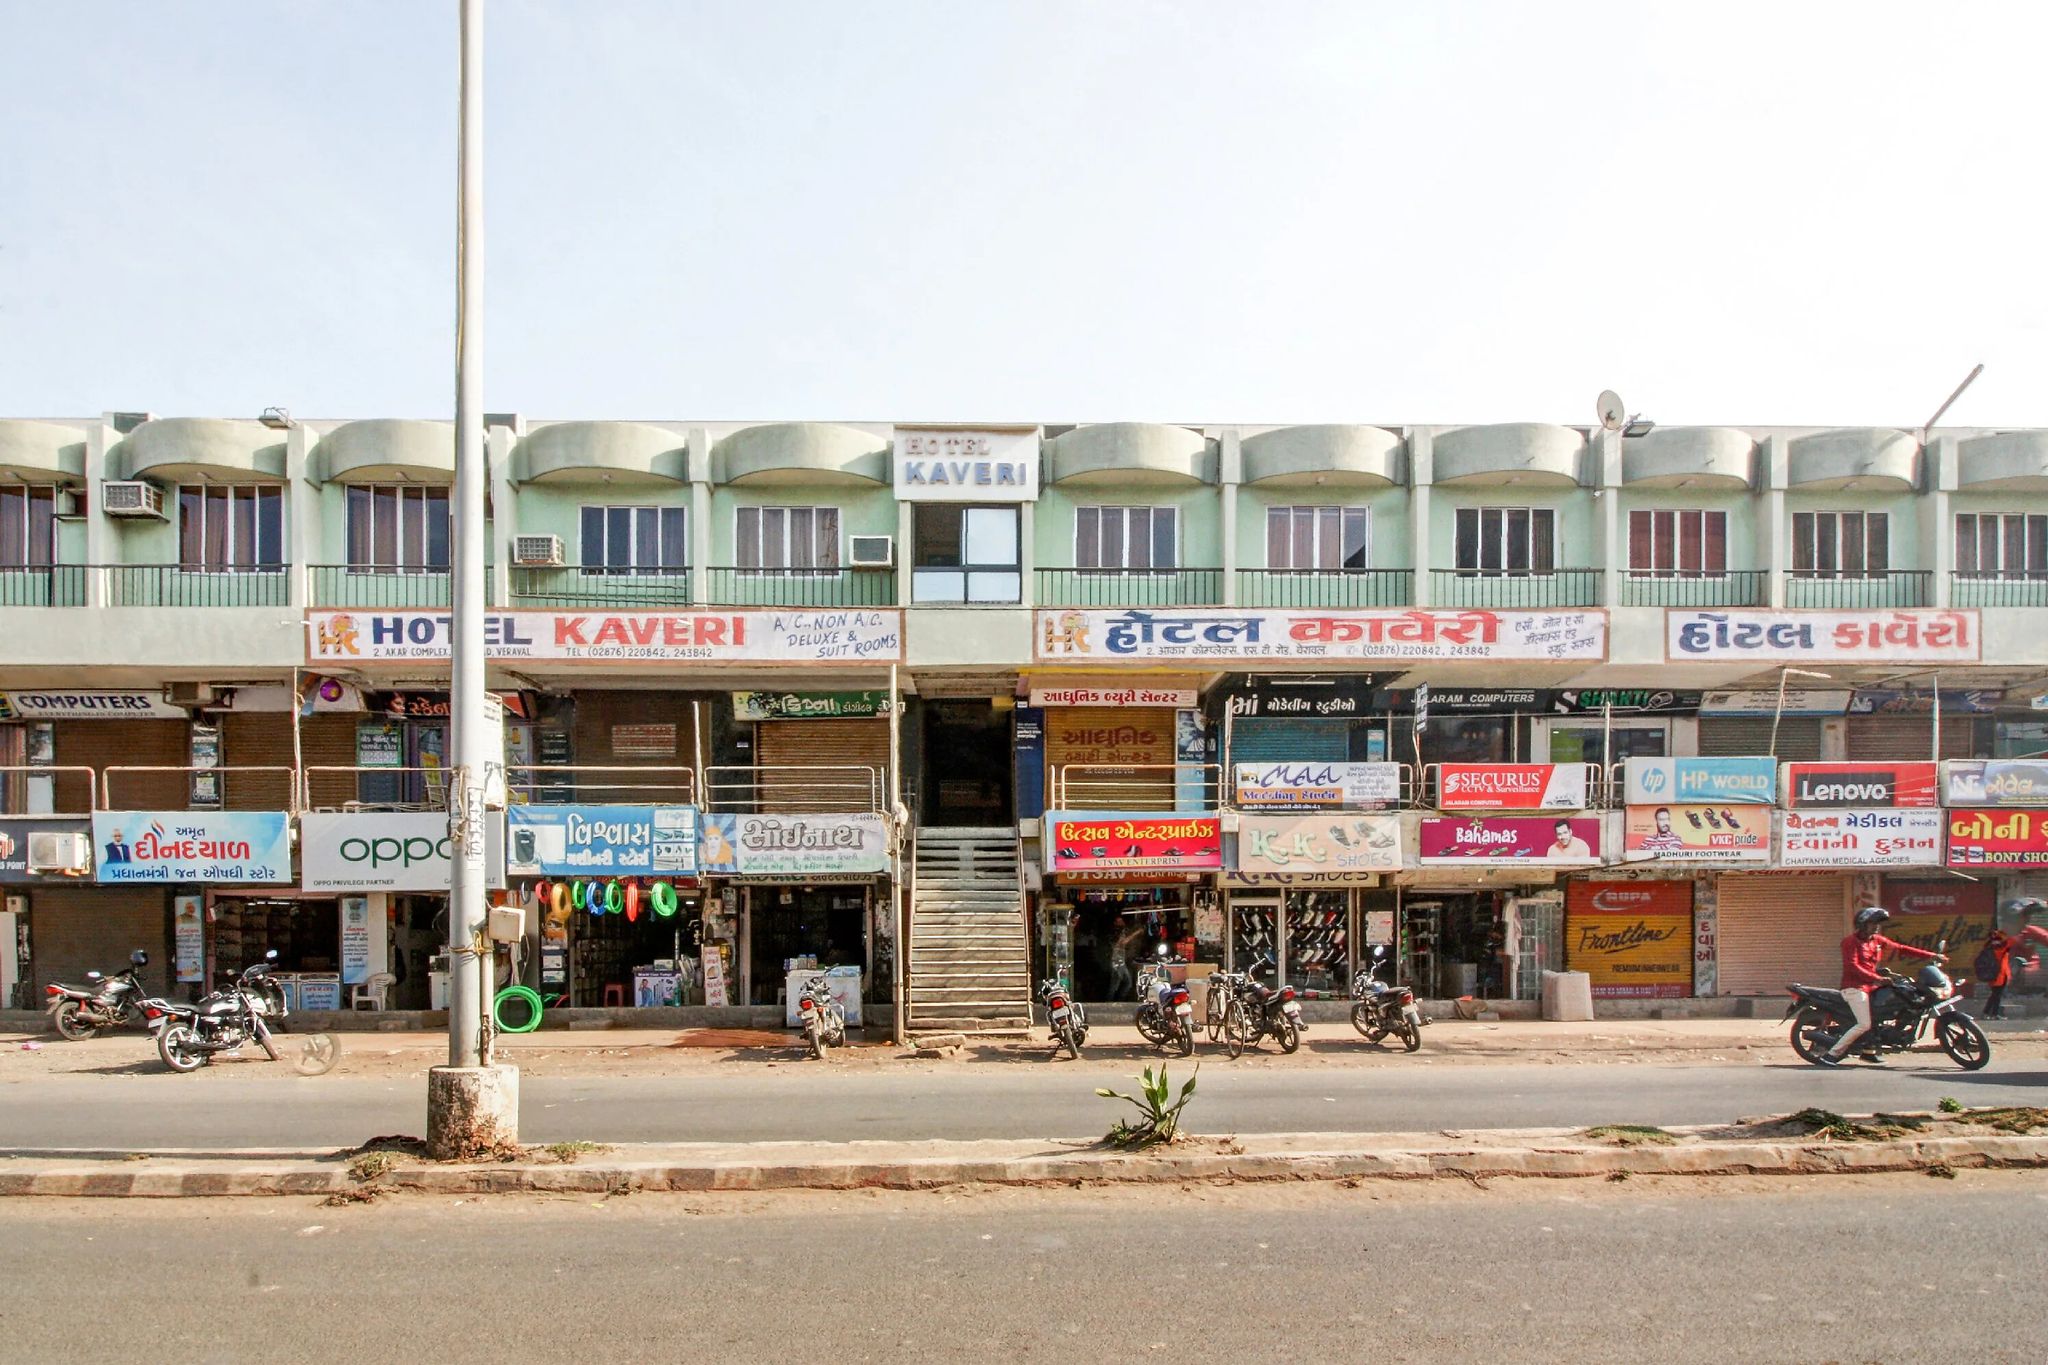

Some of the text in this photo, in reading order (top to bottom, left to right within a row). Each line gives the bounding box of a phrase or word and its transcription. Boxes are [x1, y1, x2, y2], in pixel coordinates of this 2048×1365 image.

[905, 436, 992, 455] HOTEL
[905, 461, 1027, 486] KAVERI
[814, 612, 849, 631] NON
[553, 614, 745, 647] KAVERI
[787, 629, 858, 648] DELUXE &
[1105, 610, 1504, 654] होटल कावेरी
[588, 645, 626, 660] (02876)
[673, 647, 713, 659] 243842
[816, 644, 849, 658] SUIT
[1158, 645, 1186, 656] आकार
[1449, 646, 1490, 657] 243842
[18, 694, 153, 710] COMPUTERS
[1043, 689, 1099, 705] આધુનિક
[1470, 694, 1535, 703] COMPUTERS
[1461, 772, 1540, 787] SECURUS
[1644, 769, 1664, 793] hp
[1681, 770, 1769, 790] HP WORLD
[1461, 785, 1540, 793] CCTV & Surveillance
[1802, 780, 1887, 801] Lenovo
[175, 825, 206, 842] અમૃત
[1060, 821, 1110, 842] ઉત્સવ
[1951, 812, 2031, 840] બોની
[1456, 826, 1518, 844] Bahamas
[1734, 832, 1758, 846] pride
[135, 831, 251, 861] દીનદયાળ
[1695, 850, 1742, 858] FOOTWEAR
[1095, 857, 1182, 867] UTSAV ENTERPRISE
[1336, 852, 1393, 868] SHOES
[1785, 856, 1911, 866] CHAITANYA MEDICAL AGENCIES
[1984, 851, 2022, 863] BONY
[111, 864, 169, 880] પ્રધાનમંત્રી
[175, 867, 197, 880] જન
[249, 866, 276, 880] સ્ટોર
[1579, 920, 1678, 953] Frontline
